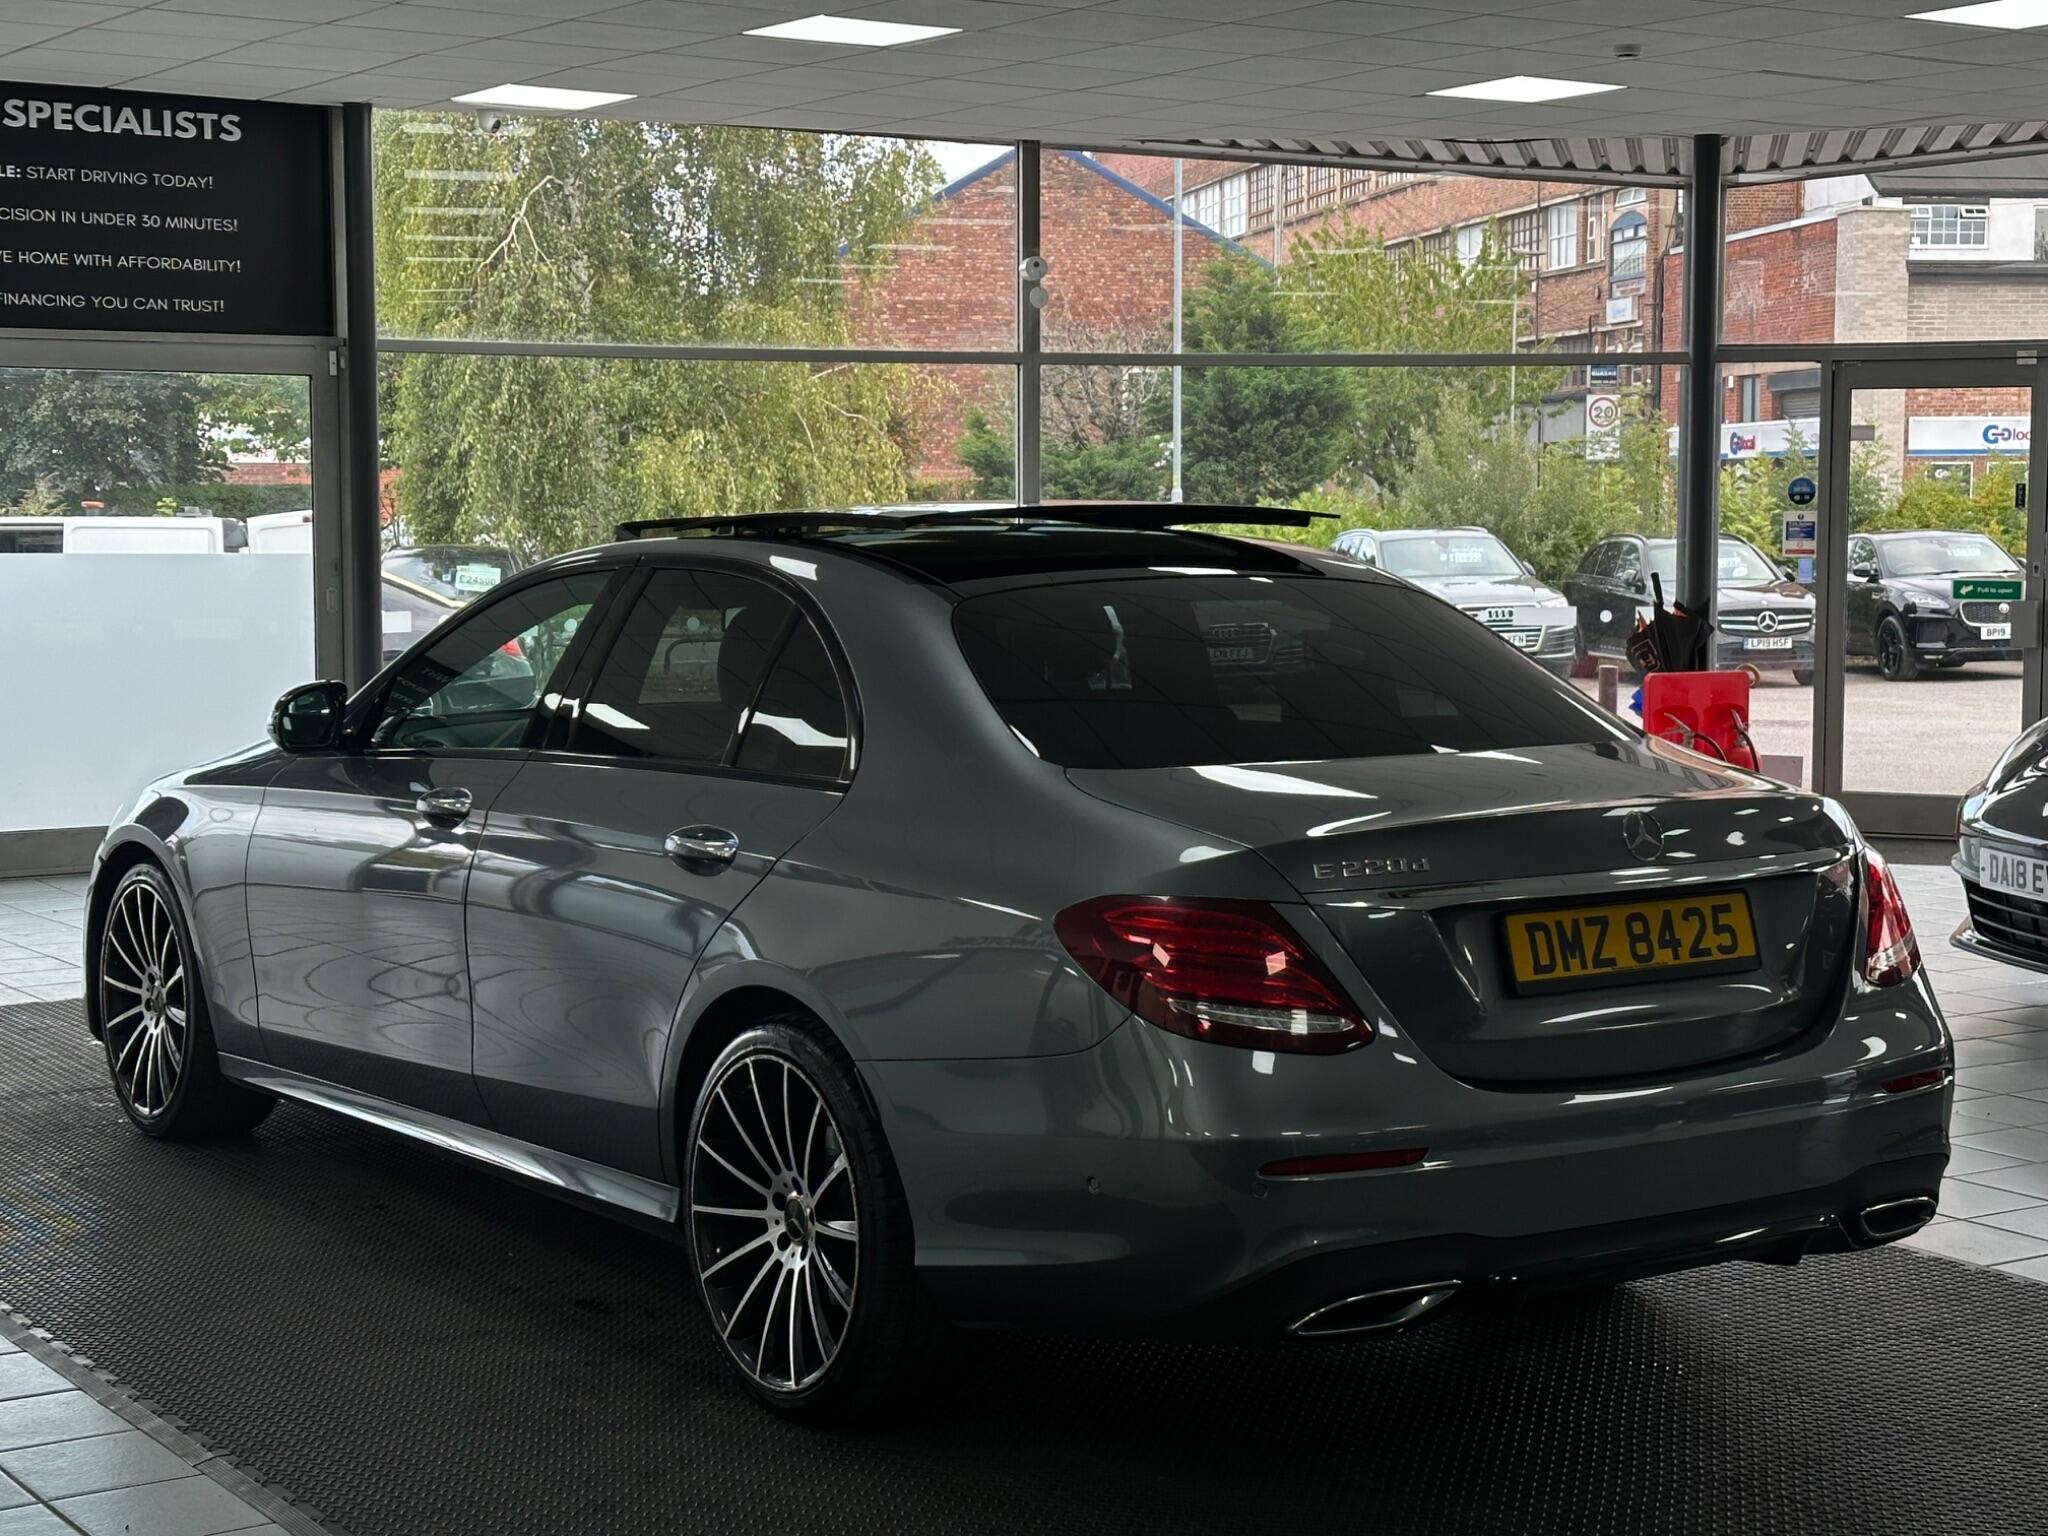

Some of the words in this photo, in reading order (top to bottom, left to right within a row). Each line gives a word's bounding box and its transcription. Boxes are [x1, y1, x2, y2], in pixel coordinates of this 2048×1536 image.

[2, 98, 242, 142] SPECIALISTS
[26, 166, 75, 181] START
[81, 169, 148, 185] DRIVING
[152, 173, 213, 190] TODAY!
[0, 207, 56, 222] CISION
[61, 210, 76, 224] IN
[81, 211, 136, 227] UNDER
[141, 214, 160, 228] 30
[165, 216, 238, 232] MINUTES!
[18, 251, 69, 266] HOME
[73, 253, 112, 268] WITH
[117, 256, 241, 273] AFFORDABILITY!
[90, 296, 128, 309] YOU
[132, 297, 168, 311] CAN
[172, 298, 225, 313] TRUST!
[1593, 406, 1614, 419] 20
[1750, 640, 1771, 648] LP19
[1989, 854, 2027, 889] DA18
[2032, 862, 2048, 894] E
[1524, 914, 1617, 976] DMZ
[1625, 903, 1739, 965] 8425
